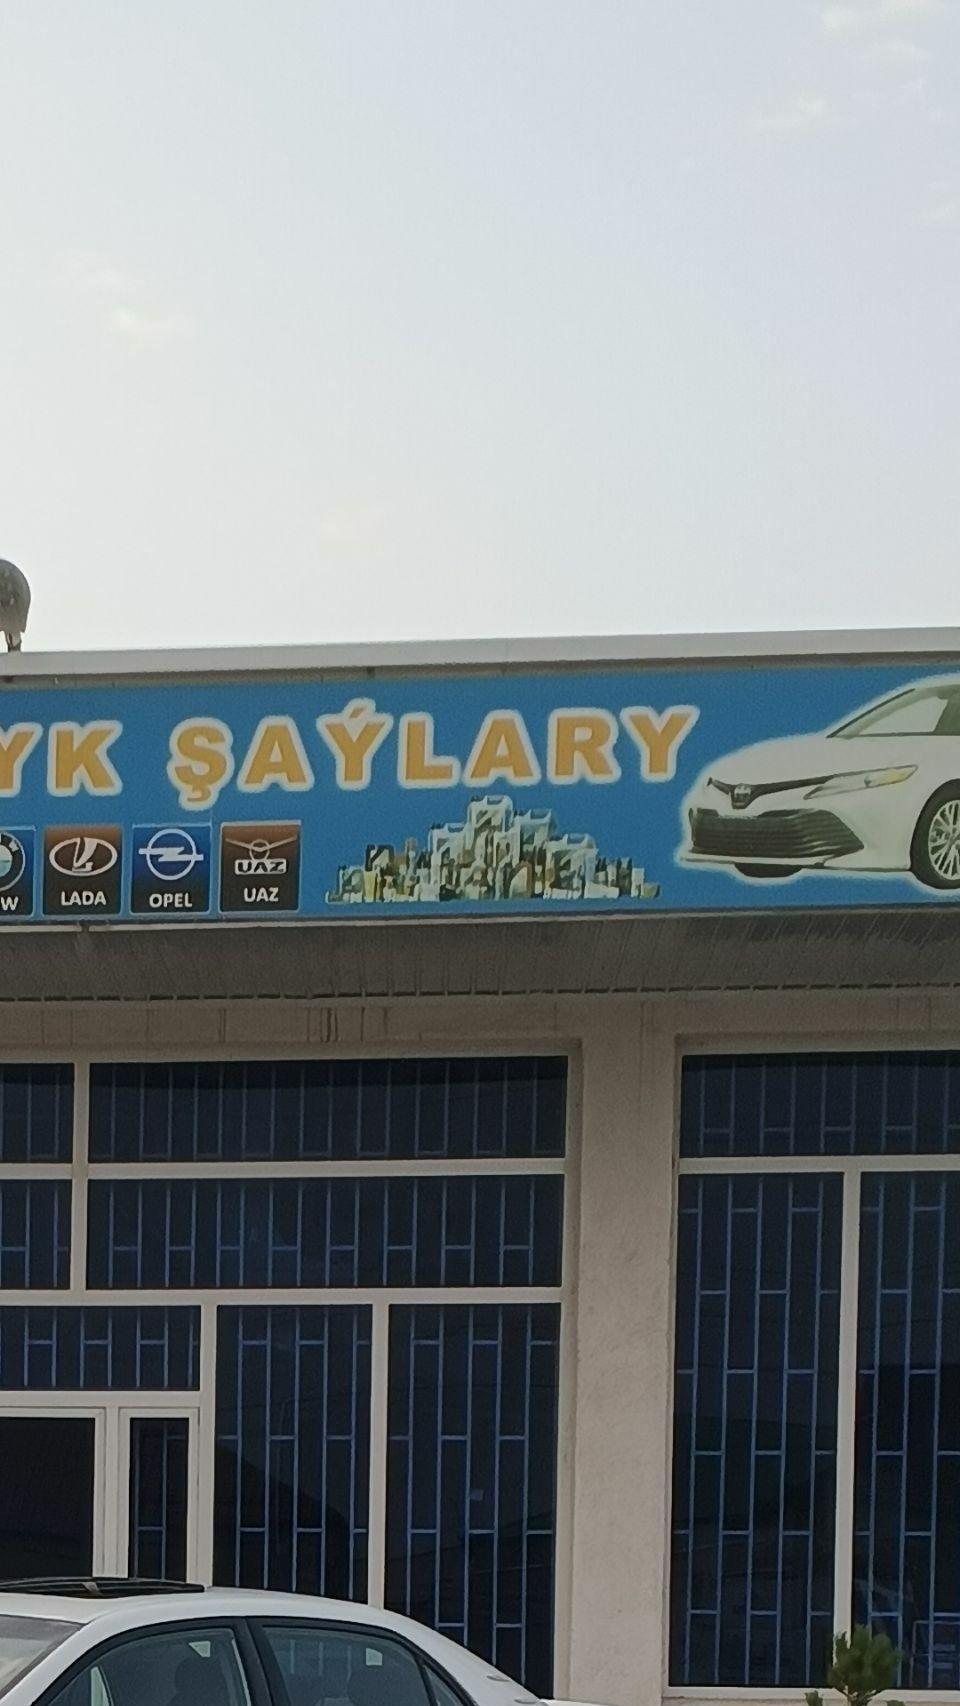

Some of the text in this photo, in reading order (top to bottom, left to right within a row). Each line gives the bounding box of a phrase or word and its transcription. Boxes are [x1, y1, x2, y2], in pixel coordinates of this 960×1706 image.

[170, 700, 698, 808] ŞAÝLARY
[60, 891, 107, 906] LADA
[149, 892, 193, 908] OPEL
[243, 887, 279, 902] UAZ
